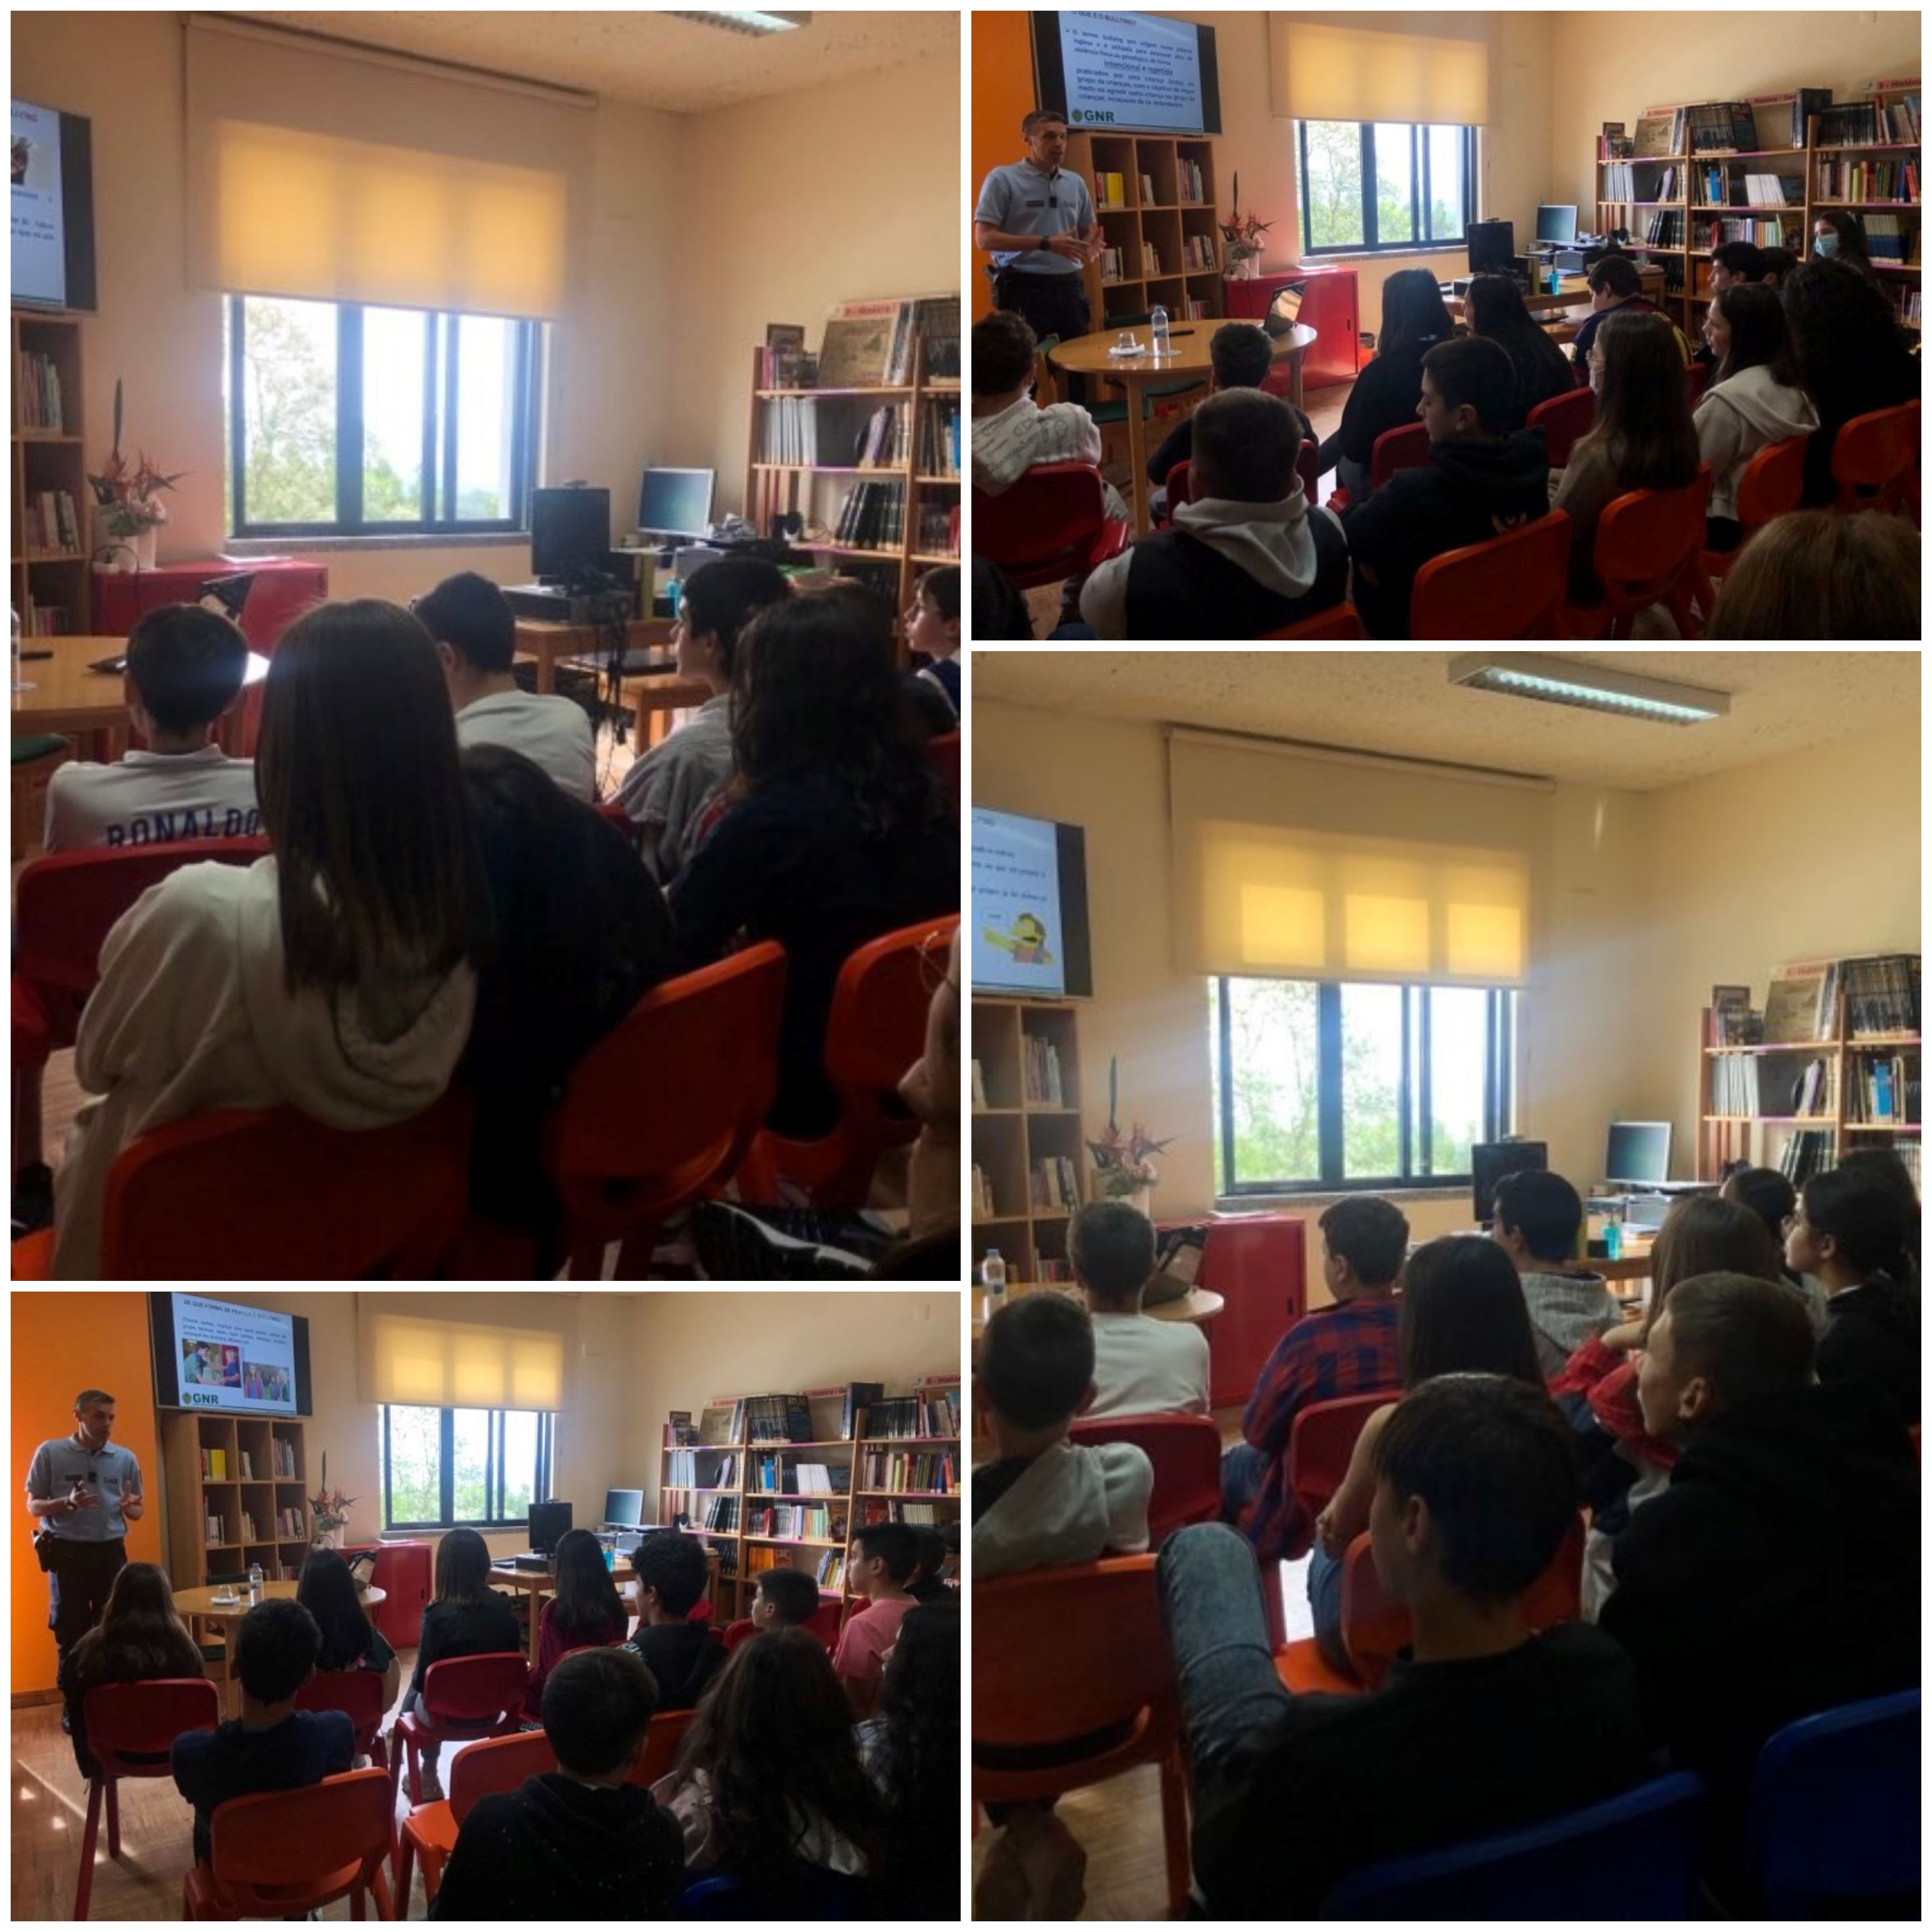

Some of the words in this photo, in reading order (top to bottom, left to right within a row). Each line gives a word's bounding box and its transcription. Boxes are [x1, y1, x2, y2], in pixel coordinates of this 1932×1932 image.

[1104, 58, 1140, 70] intencional
[1084, 109, 1115, 122] GNR
[107, 806, 260, 847] RONALDO
[193, 1393, 219, 1404] GNR
